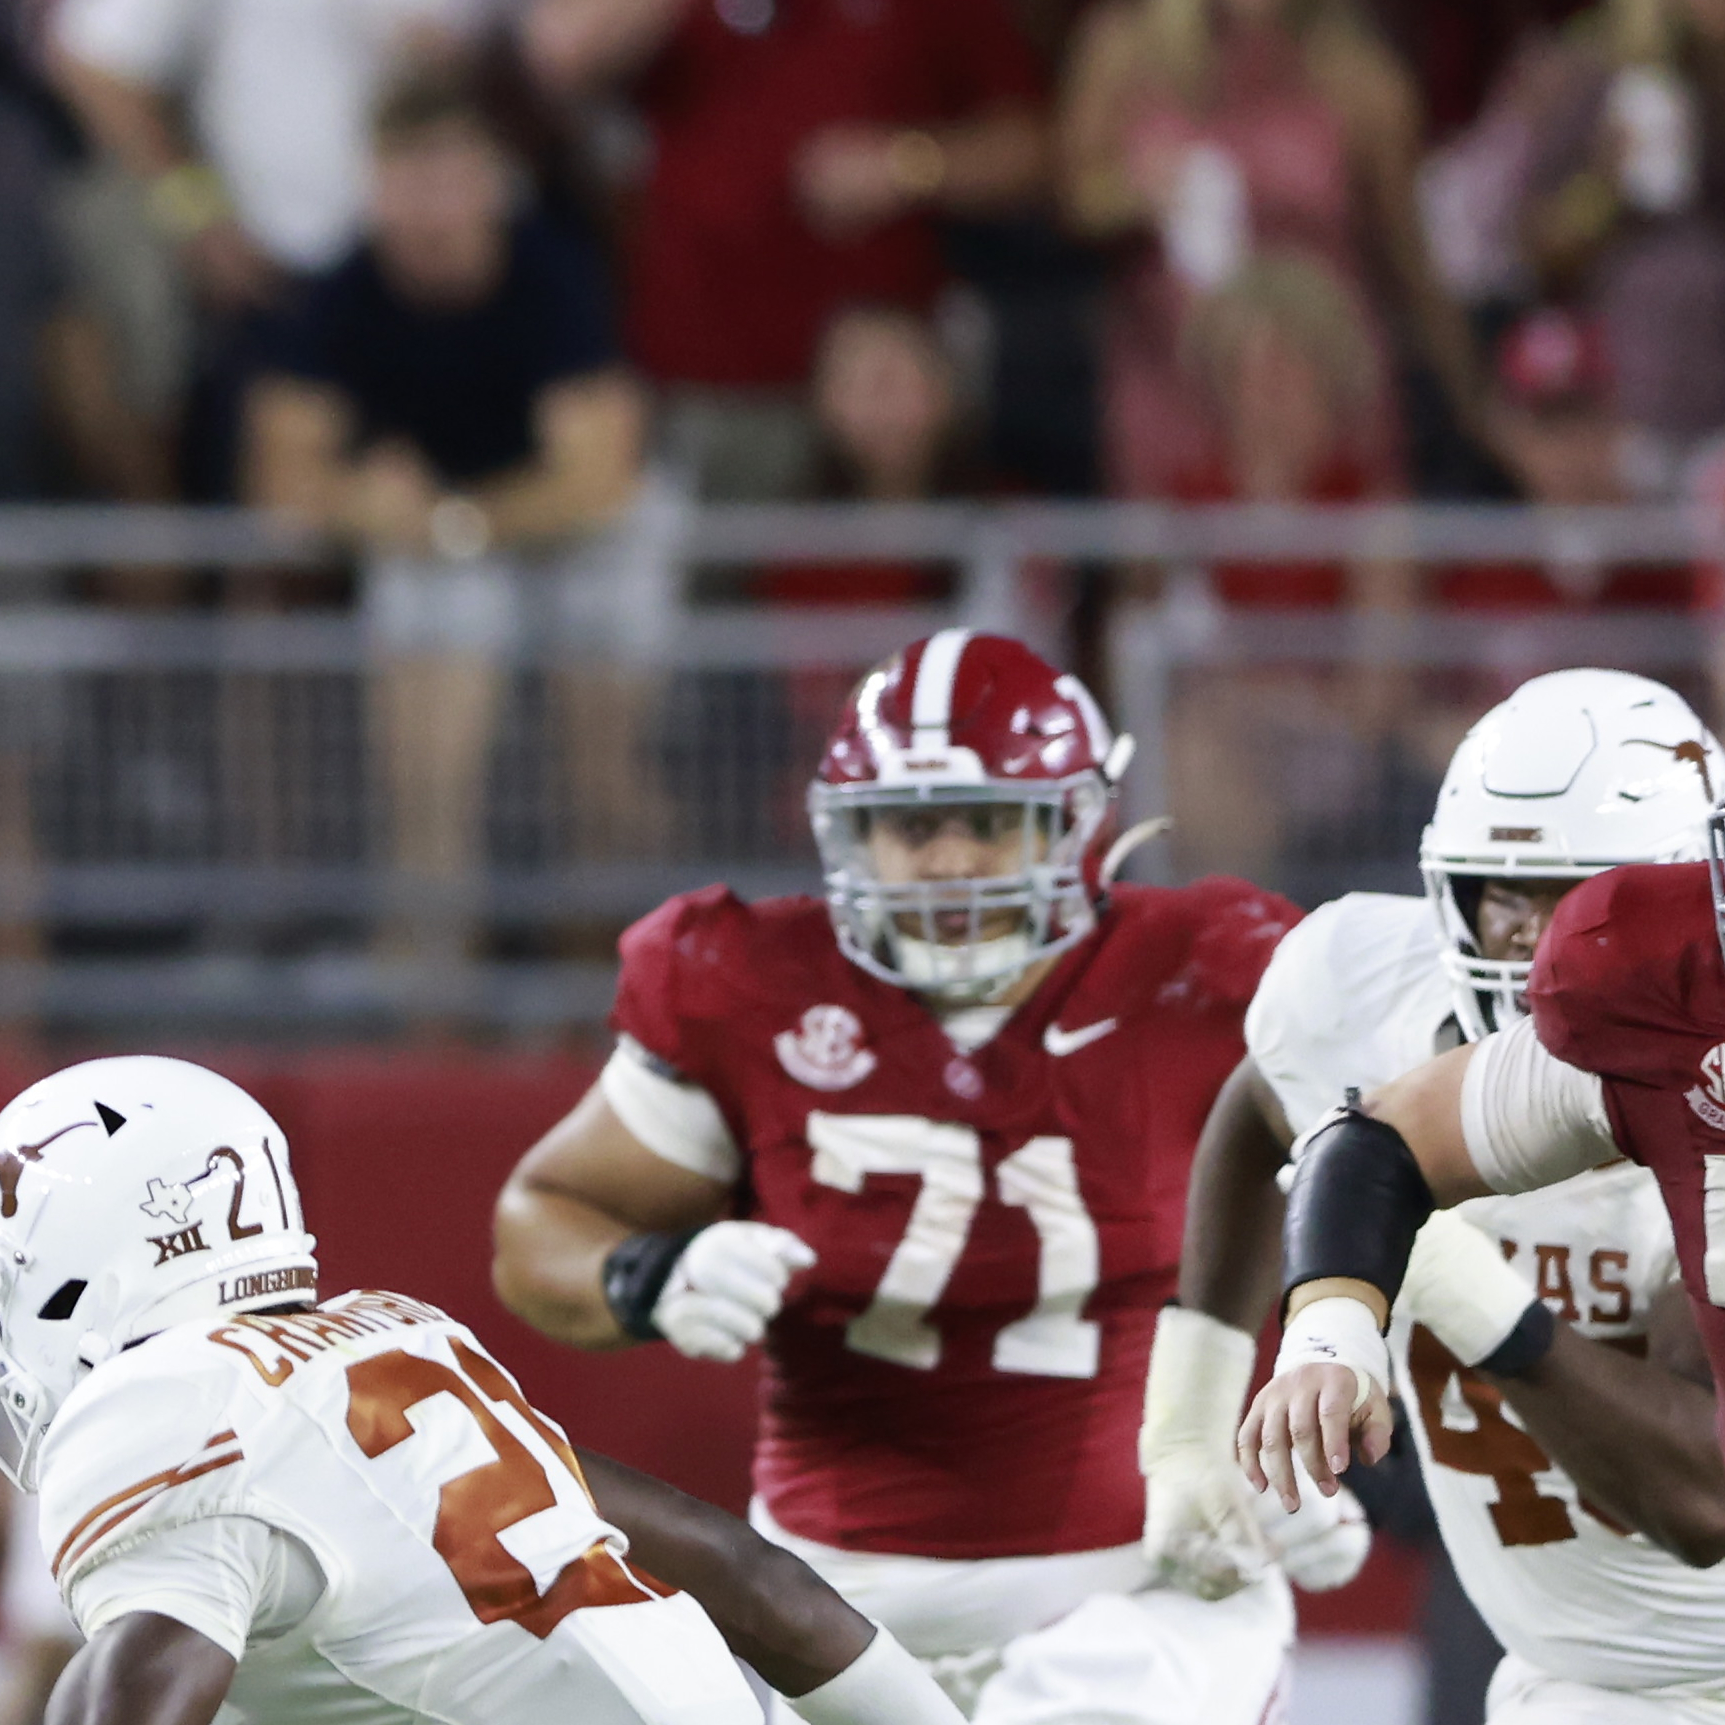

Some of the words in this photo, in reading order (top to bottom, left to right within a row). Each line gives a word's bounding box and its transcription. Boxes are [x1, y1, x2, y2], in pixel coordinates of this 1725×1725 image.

[206, 1134, 290, 1242] 21
[145, 1217, 213, 1269] XII
[806, 1110, 1100, 1379] 71
